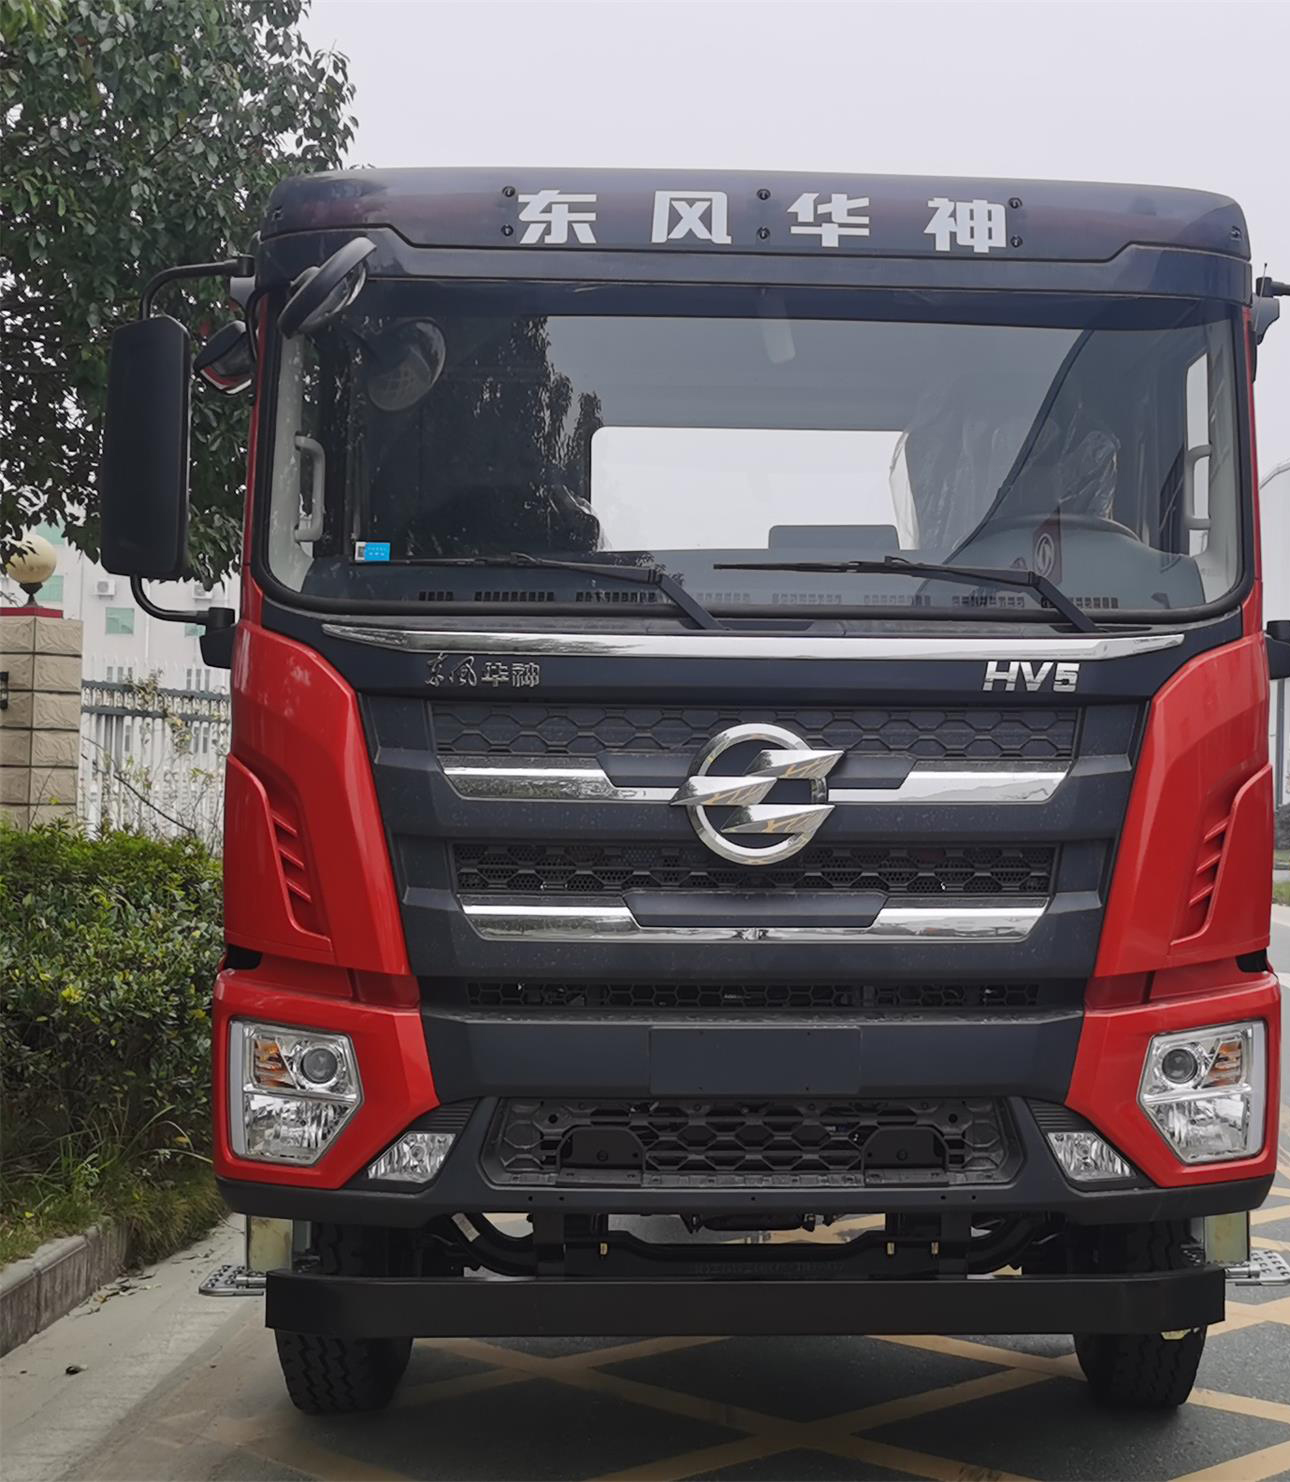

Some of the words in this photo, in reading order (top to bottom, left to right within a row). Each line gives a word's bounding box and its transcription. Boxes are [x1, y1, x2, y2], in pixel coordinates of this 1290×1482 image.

[517, 190, 1007, 253] 东风华神
[425, 652, 540, 687] 东风华神
[983, 661, 1080, 691] HV5
